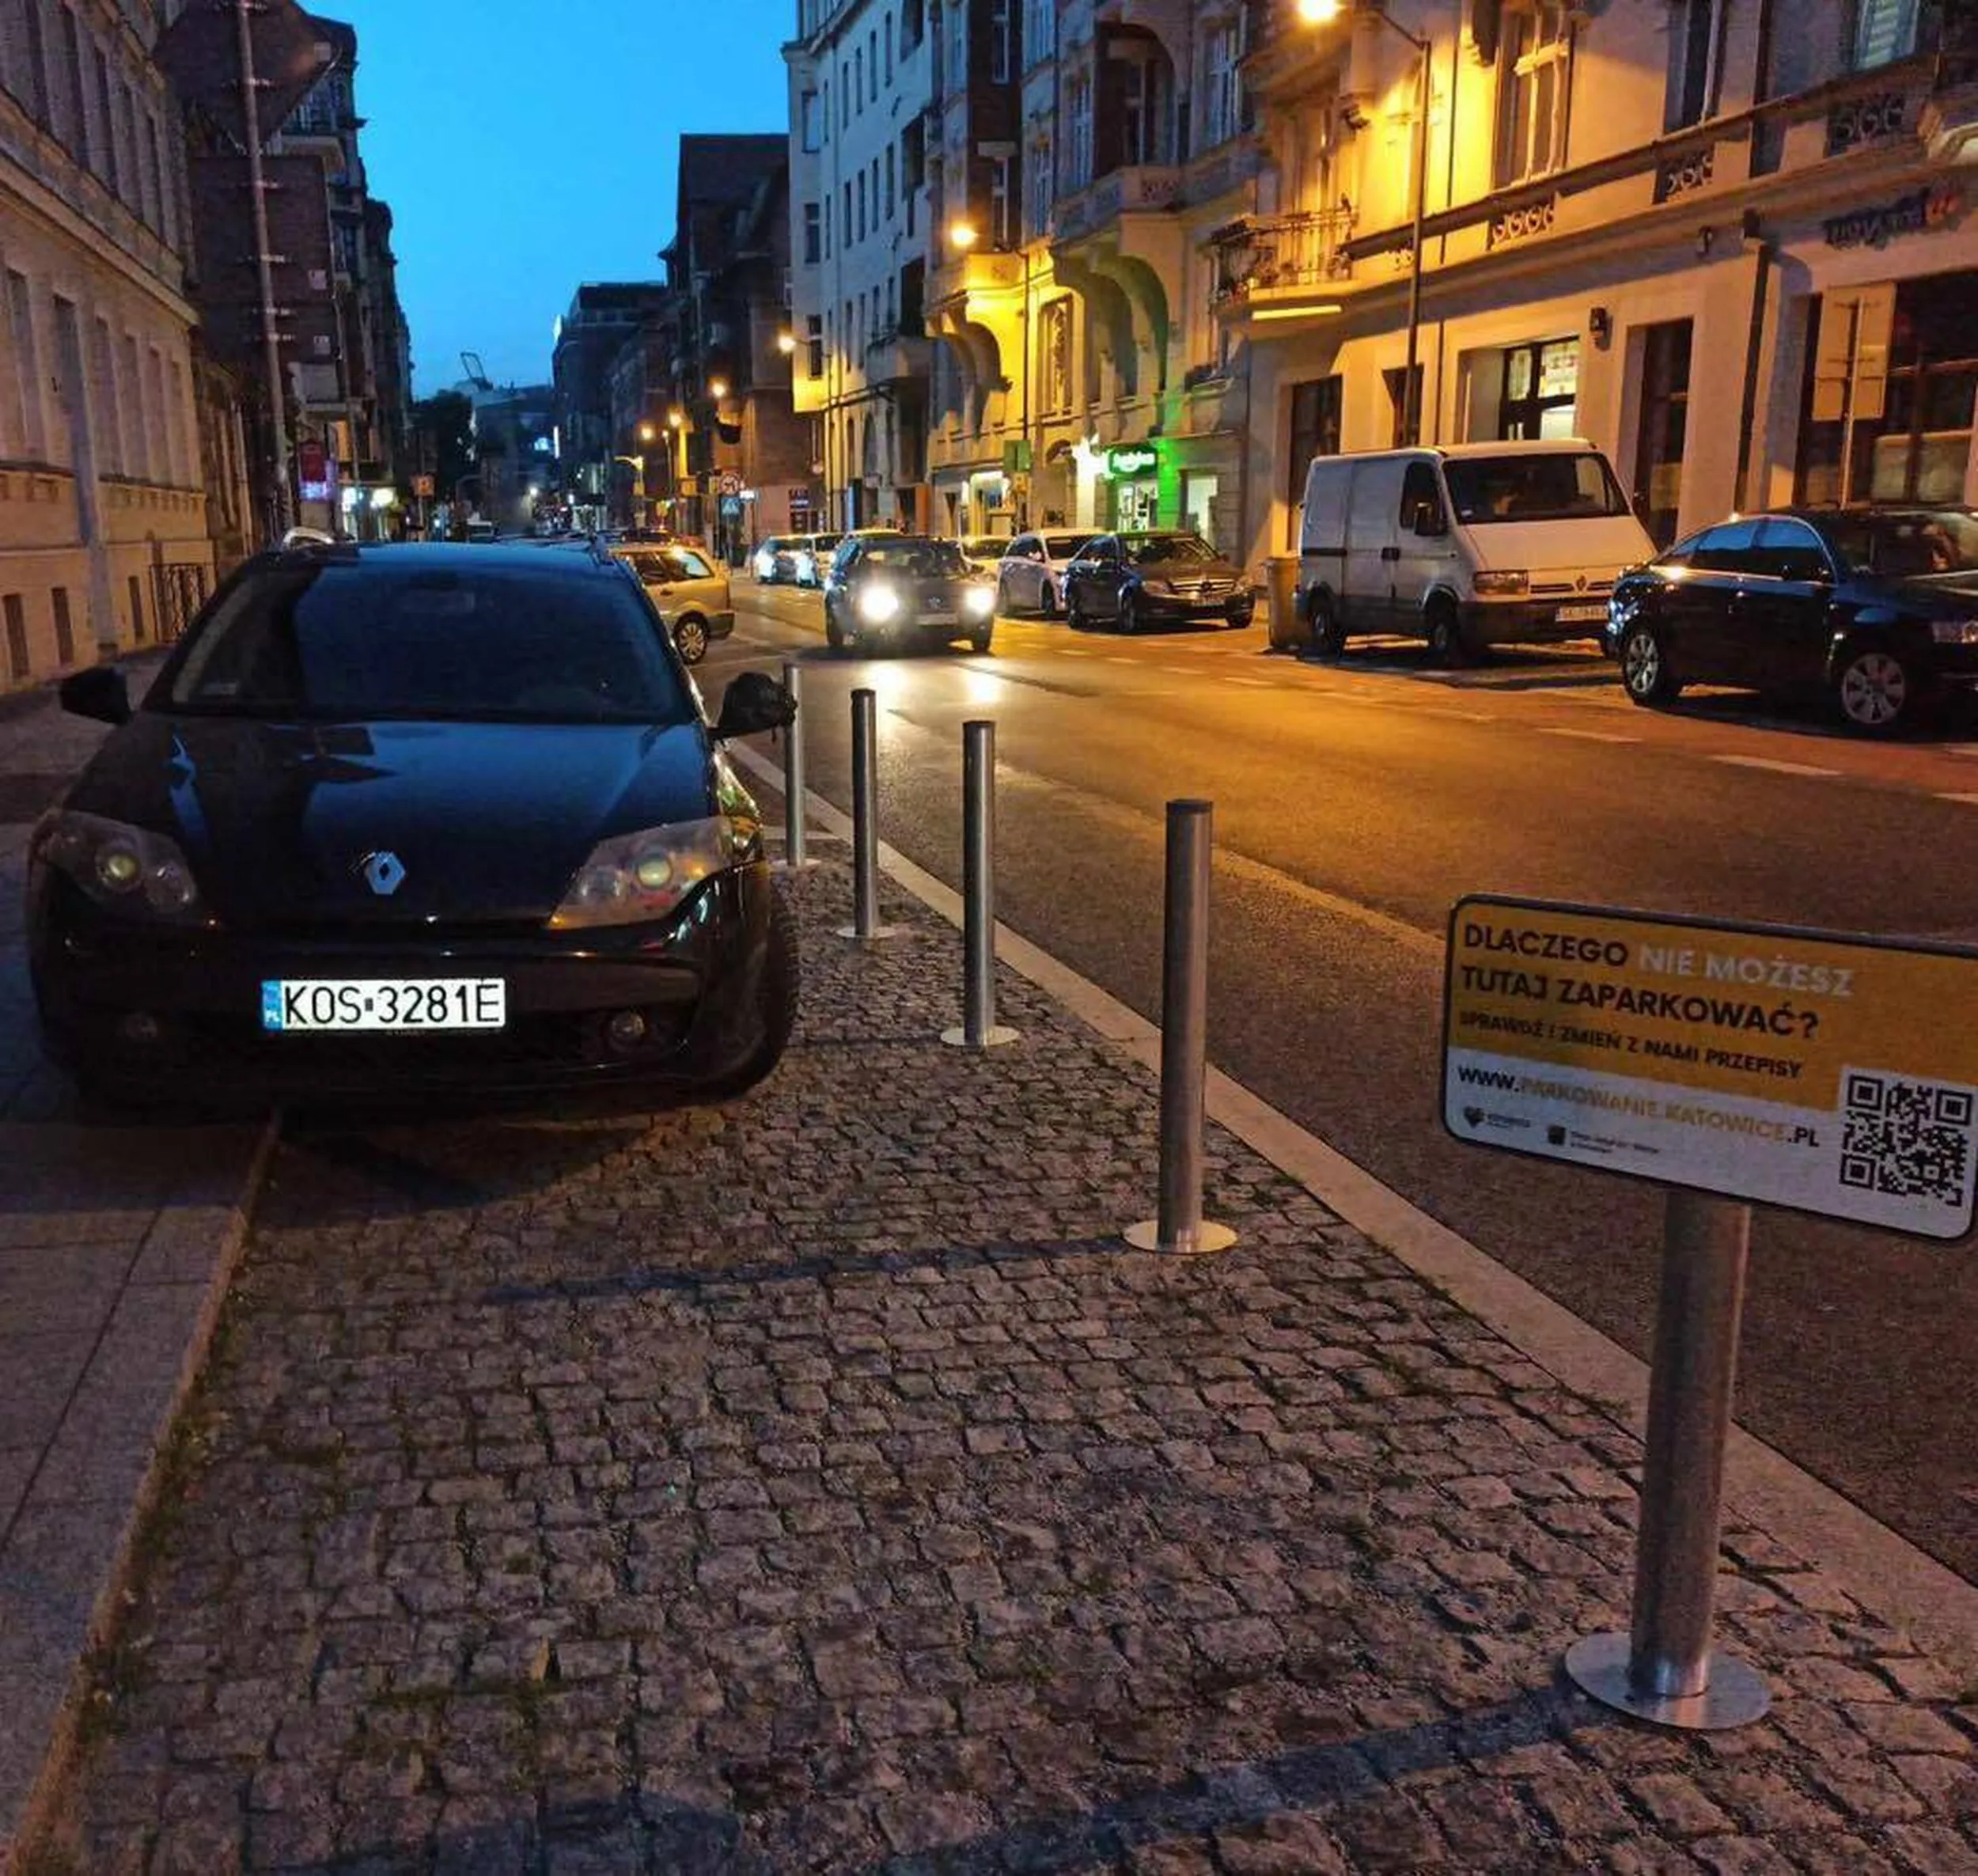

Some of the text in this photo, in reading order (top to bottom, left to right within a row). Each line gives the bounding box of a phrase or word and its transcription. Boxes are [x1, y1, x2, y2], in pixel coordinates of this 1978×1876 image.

[1465, 923, 1855, 997] DLACZEGO NIE MOŻESZ
[285, 983, 500, 1025] KOS 3281E
[1461, 965, 1820, 1039] TUTAJ ZAPARKOWAĆ?
[1627, 1036, 1640, 1054] Z
[1644, 1039, 1699, 1063] NAMI
[1704, 1048, 1803, 1079] PRZEPISY
